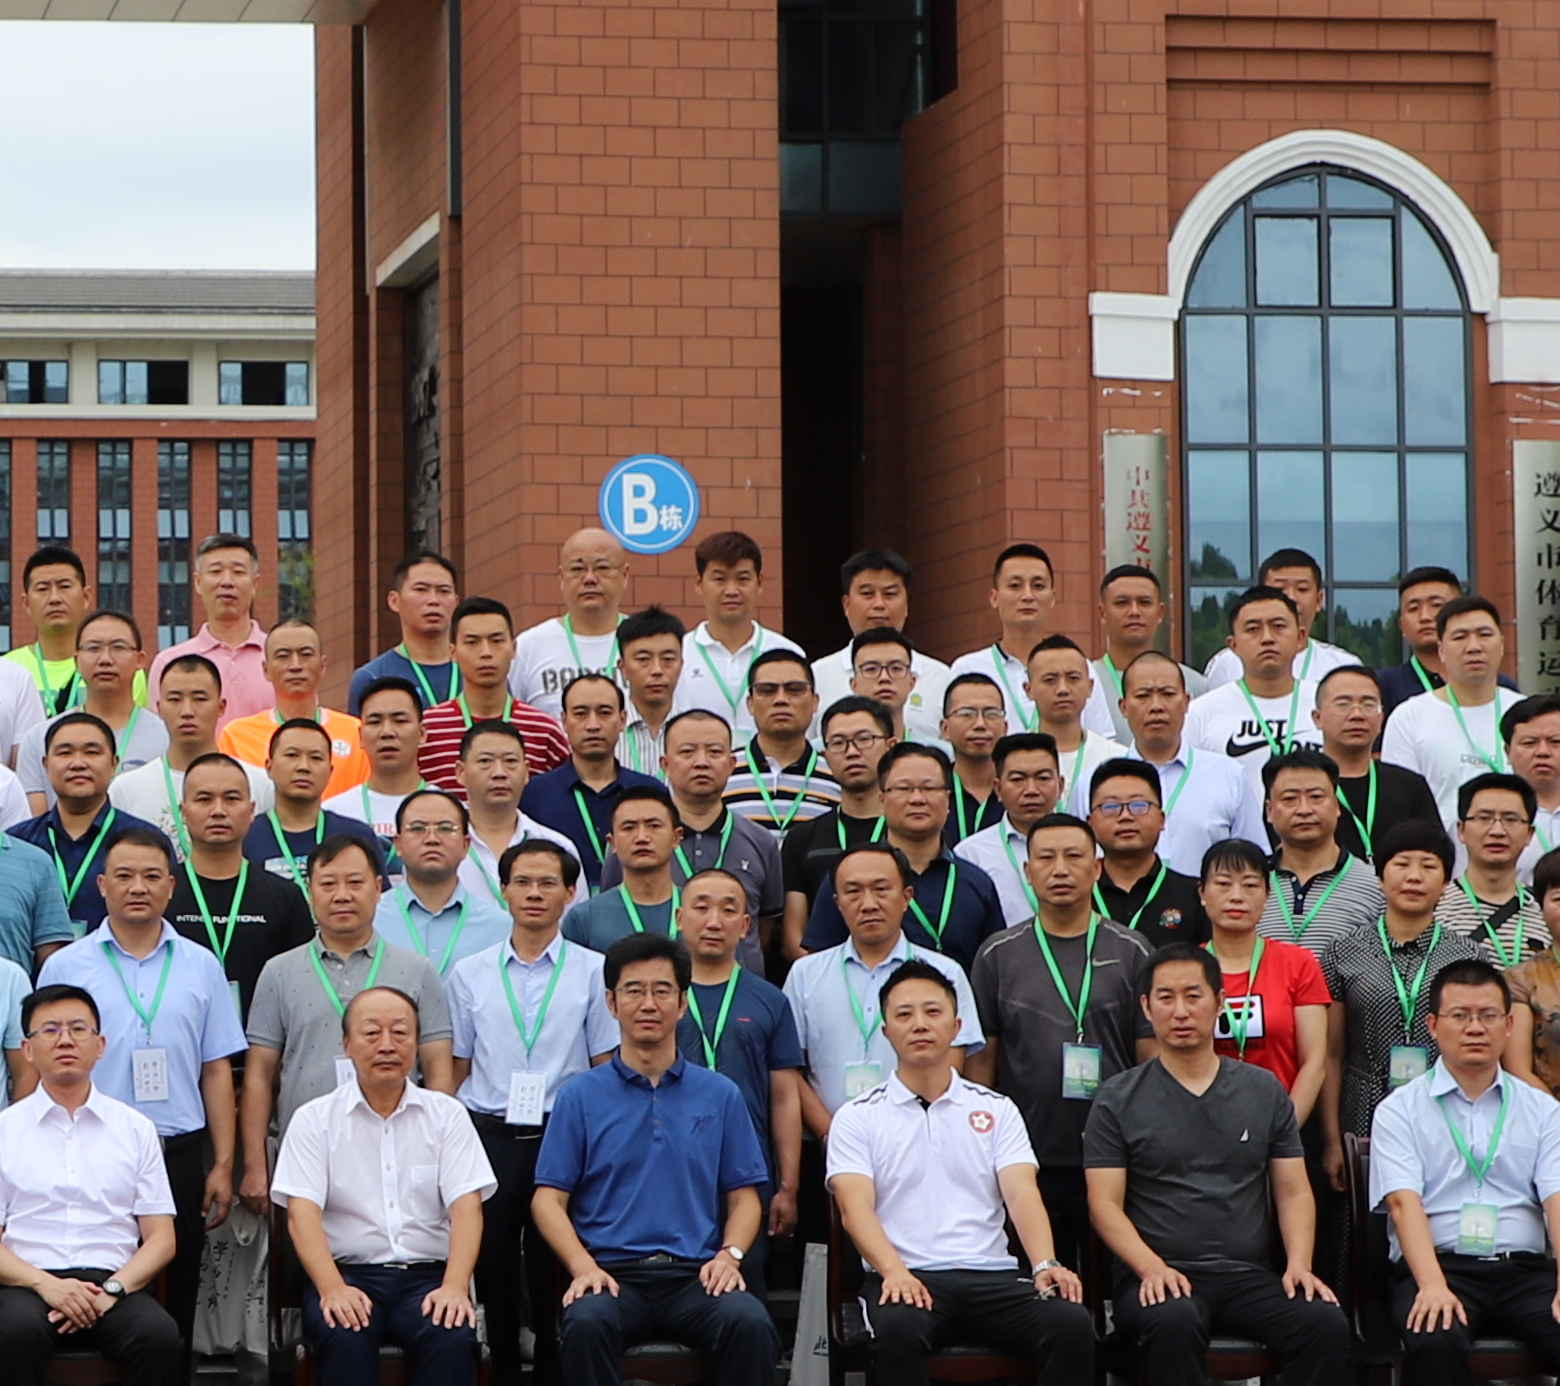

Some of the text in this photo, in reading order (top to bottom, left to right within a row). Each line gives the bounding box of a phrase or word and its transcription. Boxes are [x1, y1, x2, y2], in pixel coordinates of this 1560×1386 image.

[622, 472, 684, 536] B栋
[1236, 718, 1288, 740] JUST
[211, 915, 266, 924] FUNTIONAL
